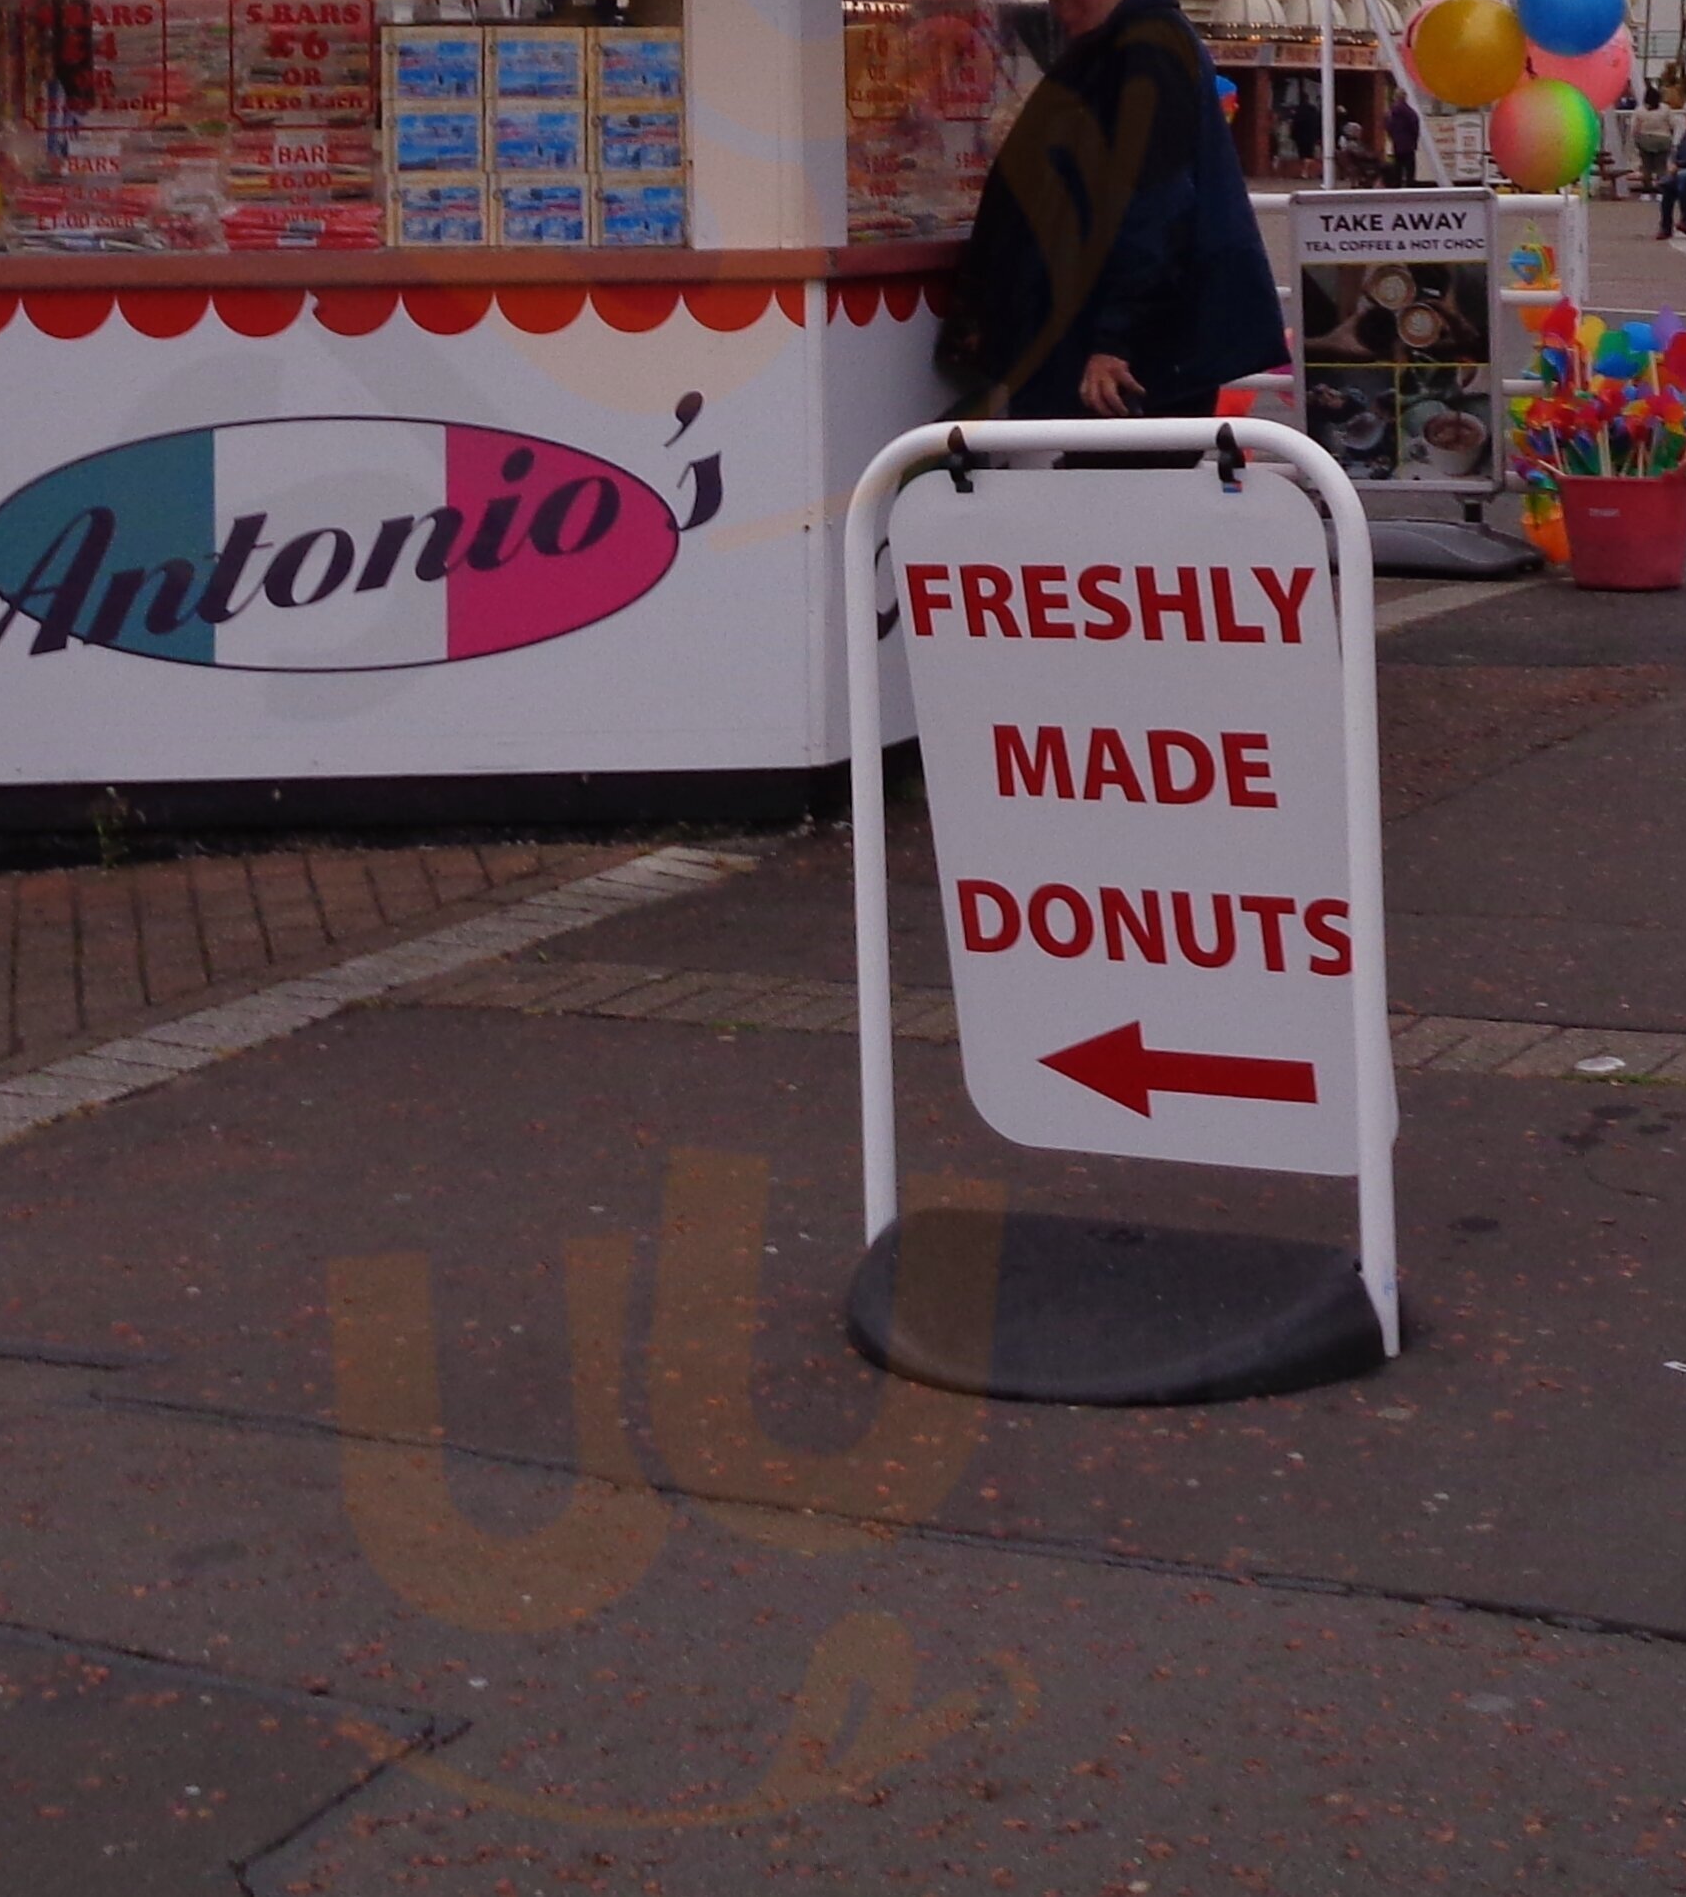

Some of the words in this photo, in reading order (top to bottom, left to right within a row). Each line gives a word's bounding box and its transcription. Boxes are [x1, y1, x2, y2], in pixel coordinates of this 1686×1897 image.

[268, 3, 362, 25] BARS
[1305, 240, 1334, 253] TEA,
[1339, 239, 1394, 252] COFFEE
[1397, 240, 1406, 251] &
[1411, 239, 1442, 251] HOT
[1444, 238, 1485, 250] CHOC
[1319, 213, 1384, 233] TAKE
[1391, 210, 1468, 232] AWAY
[903, 563, 1316, 645] FRESHLY
[992, 724, 1279, 809] MADE
[956, 878, 1354, 978] DONUTS
